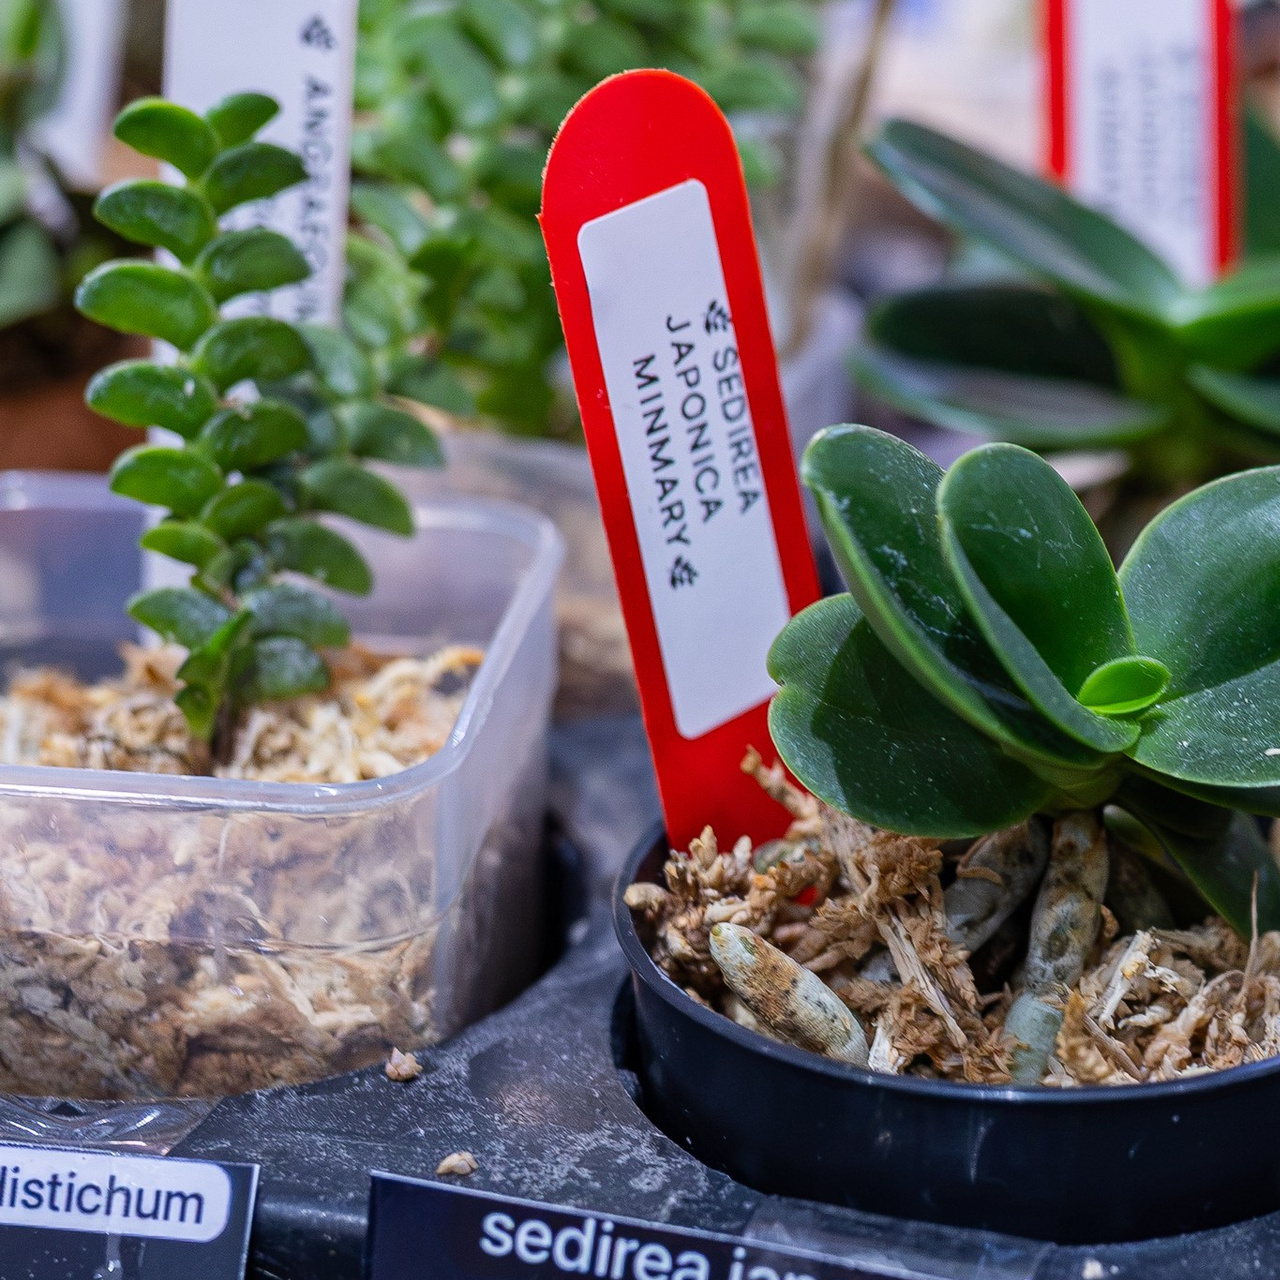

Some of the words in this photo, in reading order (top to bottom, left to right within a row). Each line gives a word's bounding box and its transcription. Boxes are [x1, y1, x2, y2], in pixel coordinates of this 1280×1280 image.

[633, 353, 691, 546] MINMARY
[666, 315, 723, 523] JAPONICA
[712, 348, 761, 515] SEDIREA
